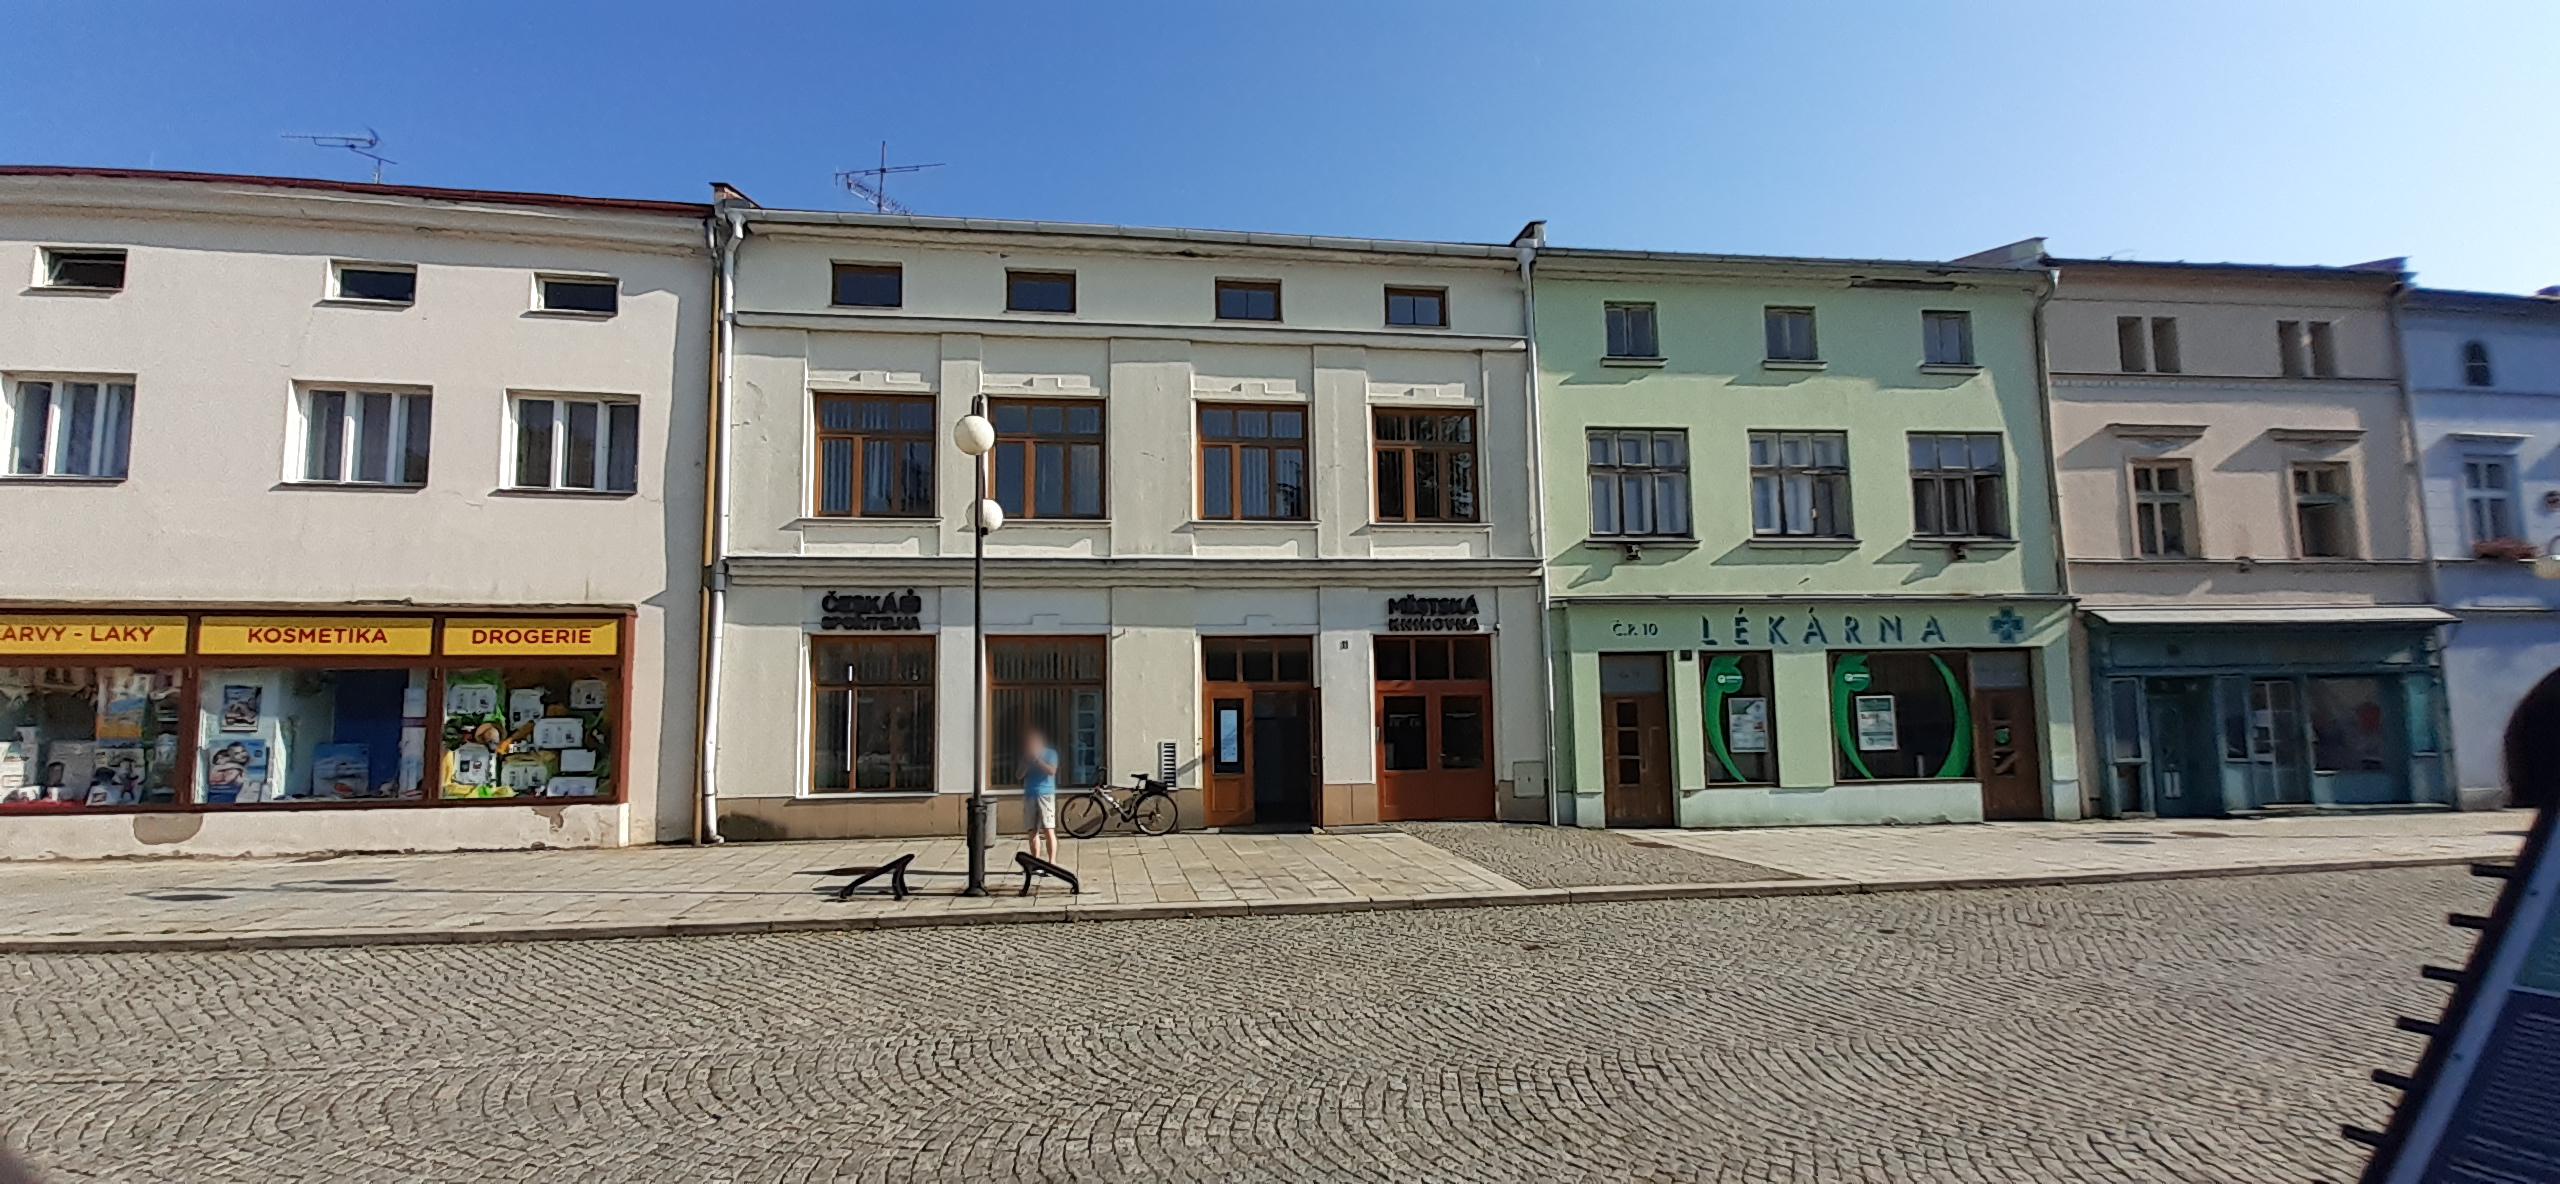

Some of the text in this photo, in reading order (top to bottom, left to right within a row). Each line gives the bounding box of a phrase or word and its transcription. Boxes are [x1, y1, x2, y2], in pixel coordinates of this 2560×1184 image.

[1642, 623, 1658, 636] 10
[1701, 607, 1946, 645] LÉKÁRNA
[0, 626, 66, 642] ARVY
[91, 626, 154, 642] LAKY
[248, 628, 388, 643] KOSMETIKA
[472, 629, 591, 644] DROGERIE
